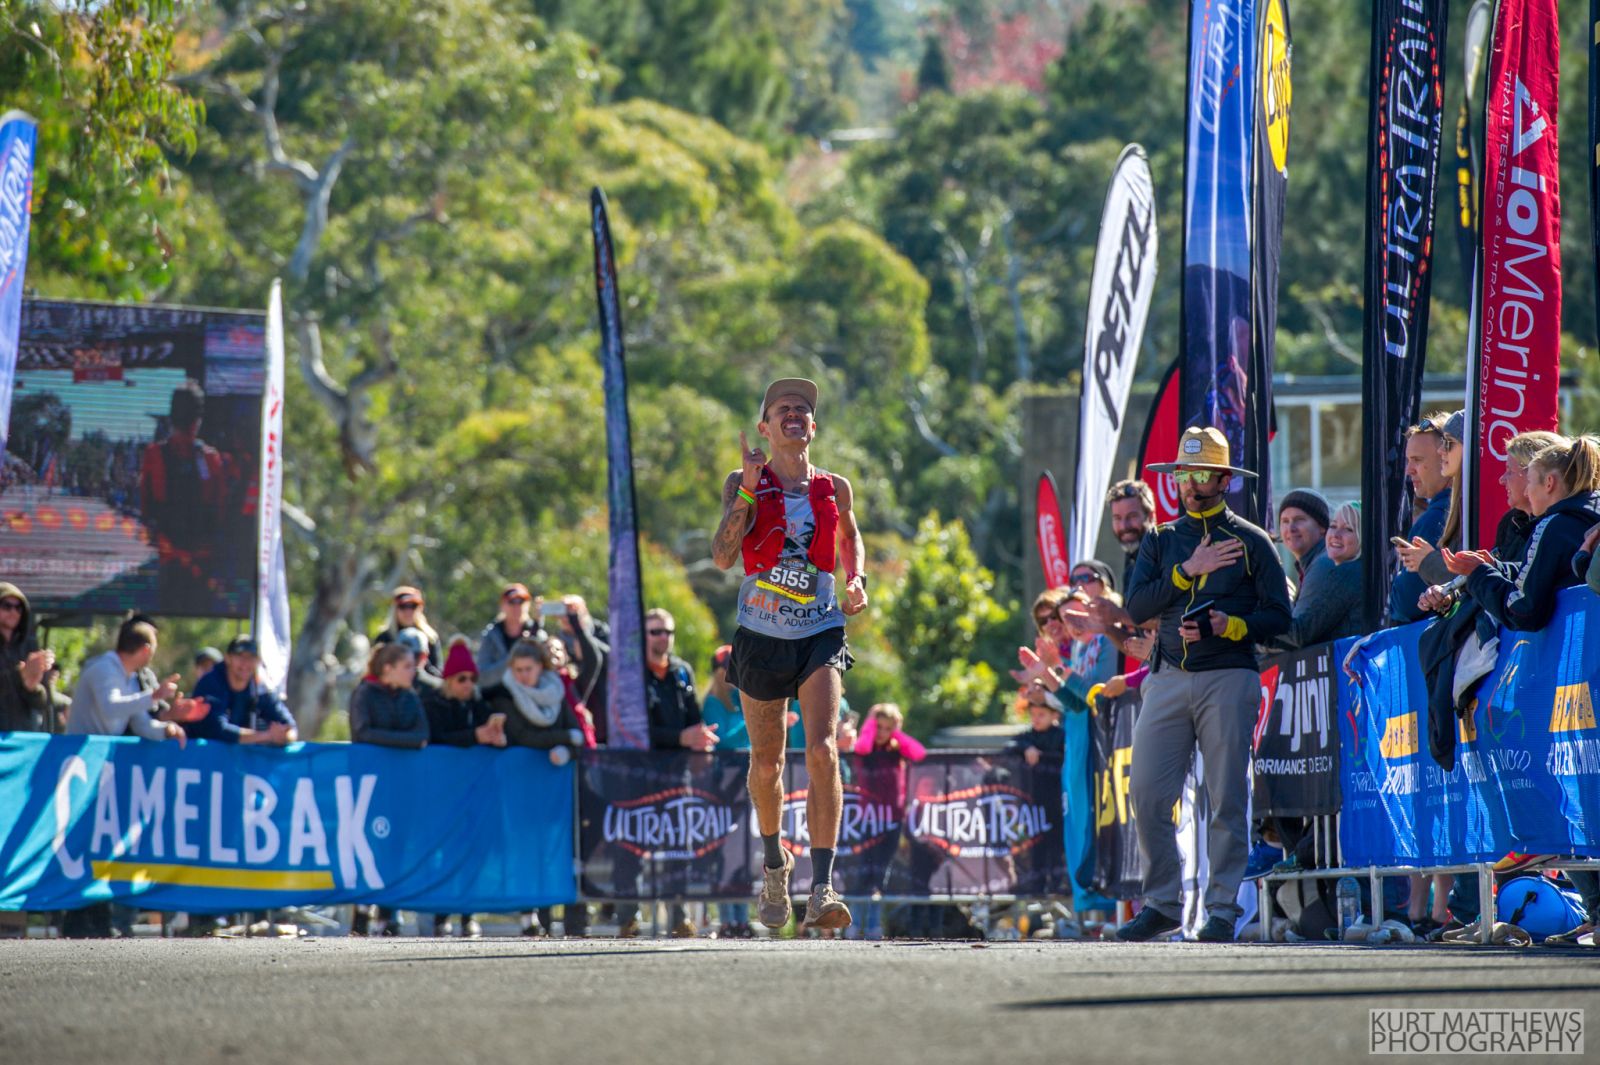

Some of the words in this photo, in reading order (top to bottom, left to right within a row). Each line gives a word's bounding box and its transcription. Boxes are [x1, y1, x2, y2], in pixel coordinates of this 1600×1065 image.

[1502, 70, 1512, 124] TRAIL
[1497, 132, 1509, 208] TESTED
[1489, 234, 1500, 298] ULTRA
[769, 566, 809, 589] 5155
[759, 610, 777, 625] LIFE
